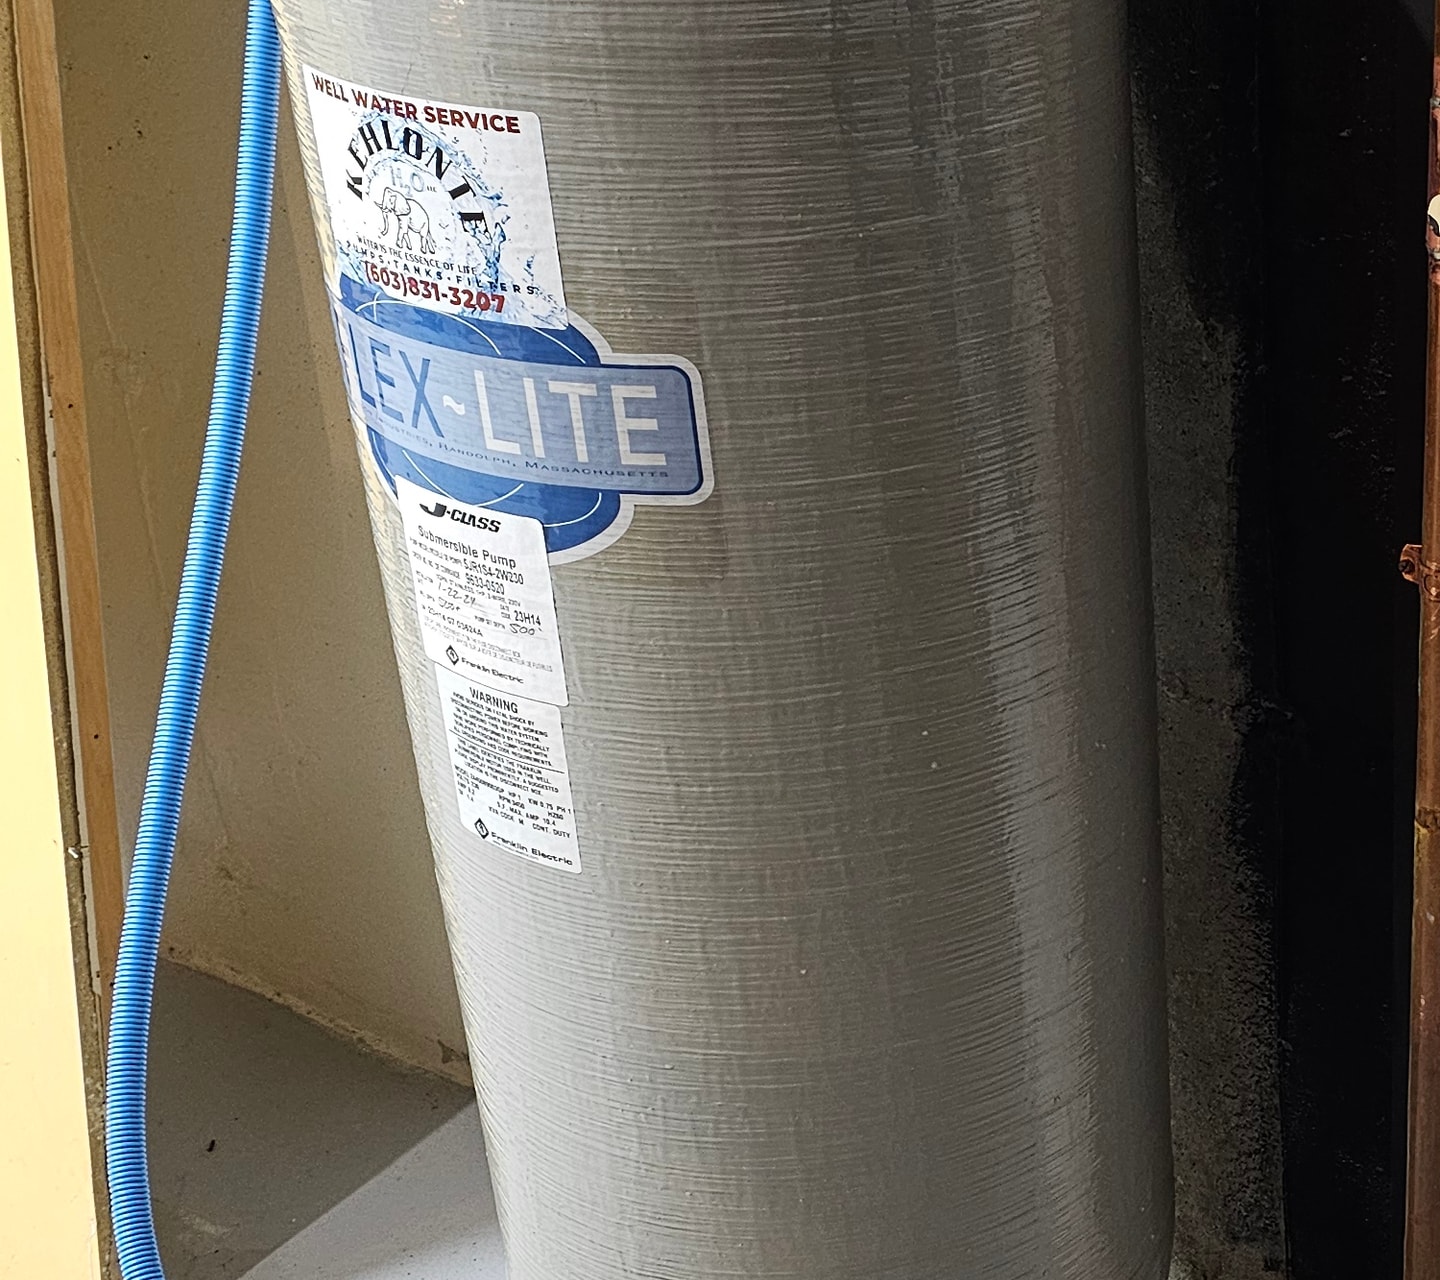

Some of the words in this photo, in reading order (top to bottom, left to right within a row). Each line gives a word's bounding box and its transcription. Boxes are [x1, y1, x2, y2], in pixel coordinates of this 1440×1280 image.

[312, 72, 349, 102] WELL
[351, 88, 418, 121] WATER
[423, 105, 521, 134] SERVICE
[357, 234, 380, 251] WATER
[388, 246, 402, 260] THE
[404, 252, 440, 270] ESSENCE
[443, 262, 455, 271] OF
[457, 264, 477, 276] LIFE
[363, 260, 505, 314] (603)831-3207
[456, 276, 536, 295] FILTERS
[524, 460, 670, 478] MASSACHUSETTS
[418, 525, 478, 558] Submersible
[482, 549, 517, 569] Pump
[462, 656, 491, 675] Franklin
[492, 670, 524, 684] Electric
[469, 686, 518, 714] WARNING
[492, 831, 528, 852] Franklin
[531, 848, 573, 866] Electric
